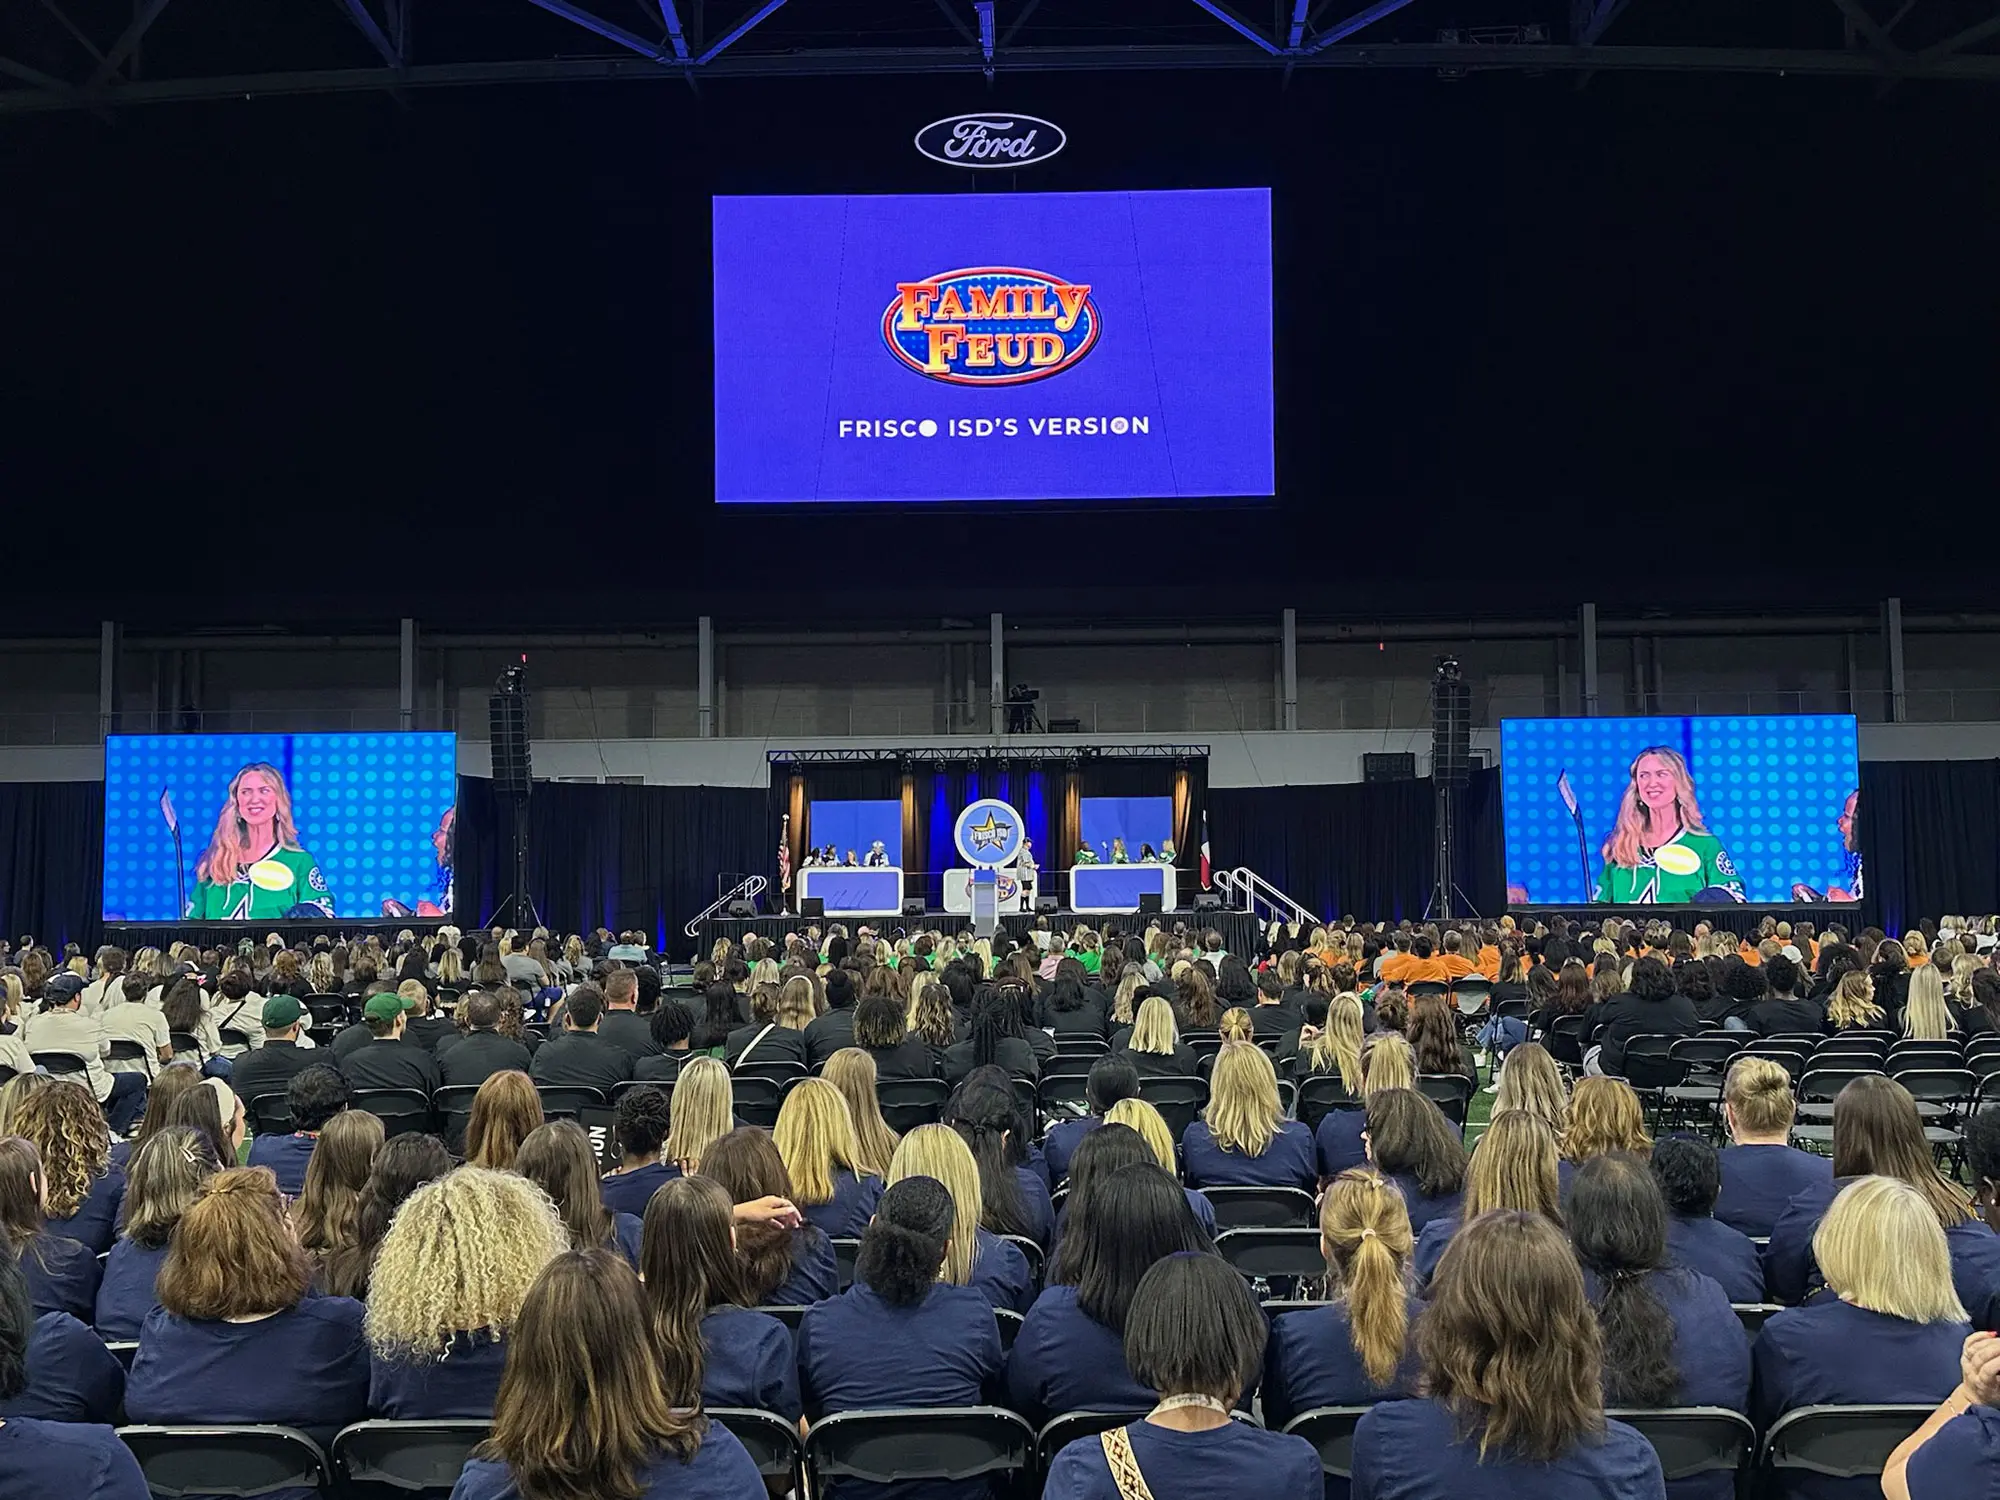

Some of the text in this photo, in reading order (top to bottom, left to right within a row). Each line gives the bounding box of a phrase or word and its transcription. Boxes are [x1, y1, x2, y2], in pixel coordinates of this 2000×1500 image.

[944, 120, 1037, 158] Ford
[896, 282, 1090, 332] FAMILY
[922, 323, 1066, 374] FEUD
[838, 415, 1150, 438] FRISCO ISD'S VERSION
